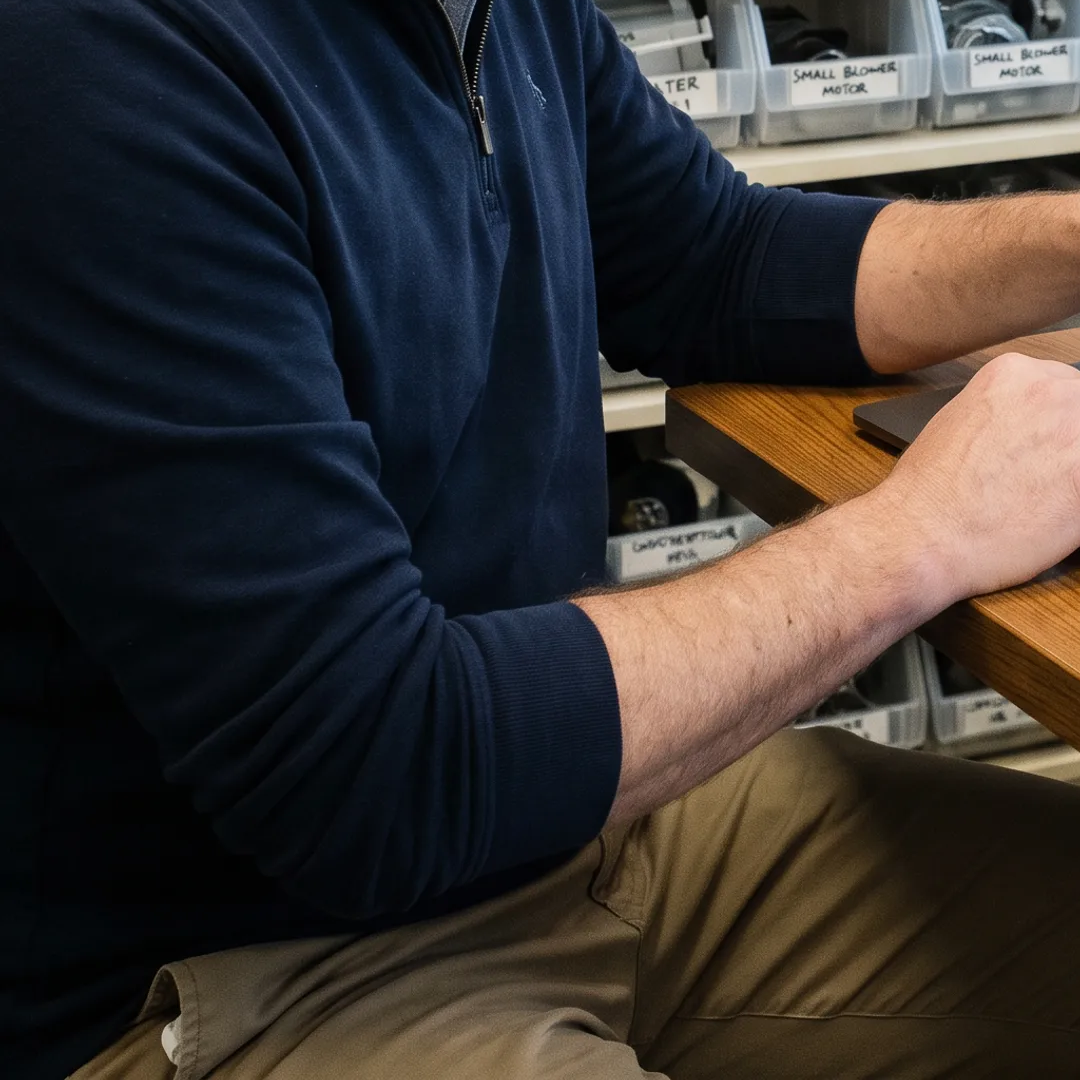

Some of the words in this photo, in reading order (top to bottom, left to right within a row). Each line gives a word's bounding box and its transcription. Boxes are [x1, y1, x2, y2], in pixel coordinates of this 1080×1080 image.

[974, 52, 1014, 66] SMALL
[793, 66, 836, 82] SMALL
[821, 82, 869, 97] MOTOR
